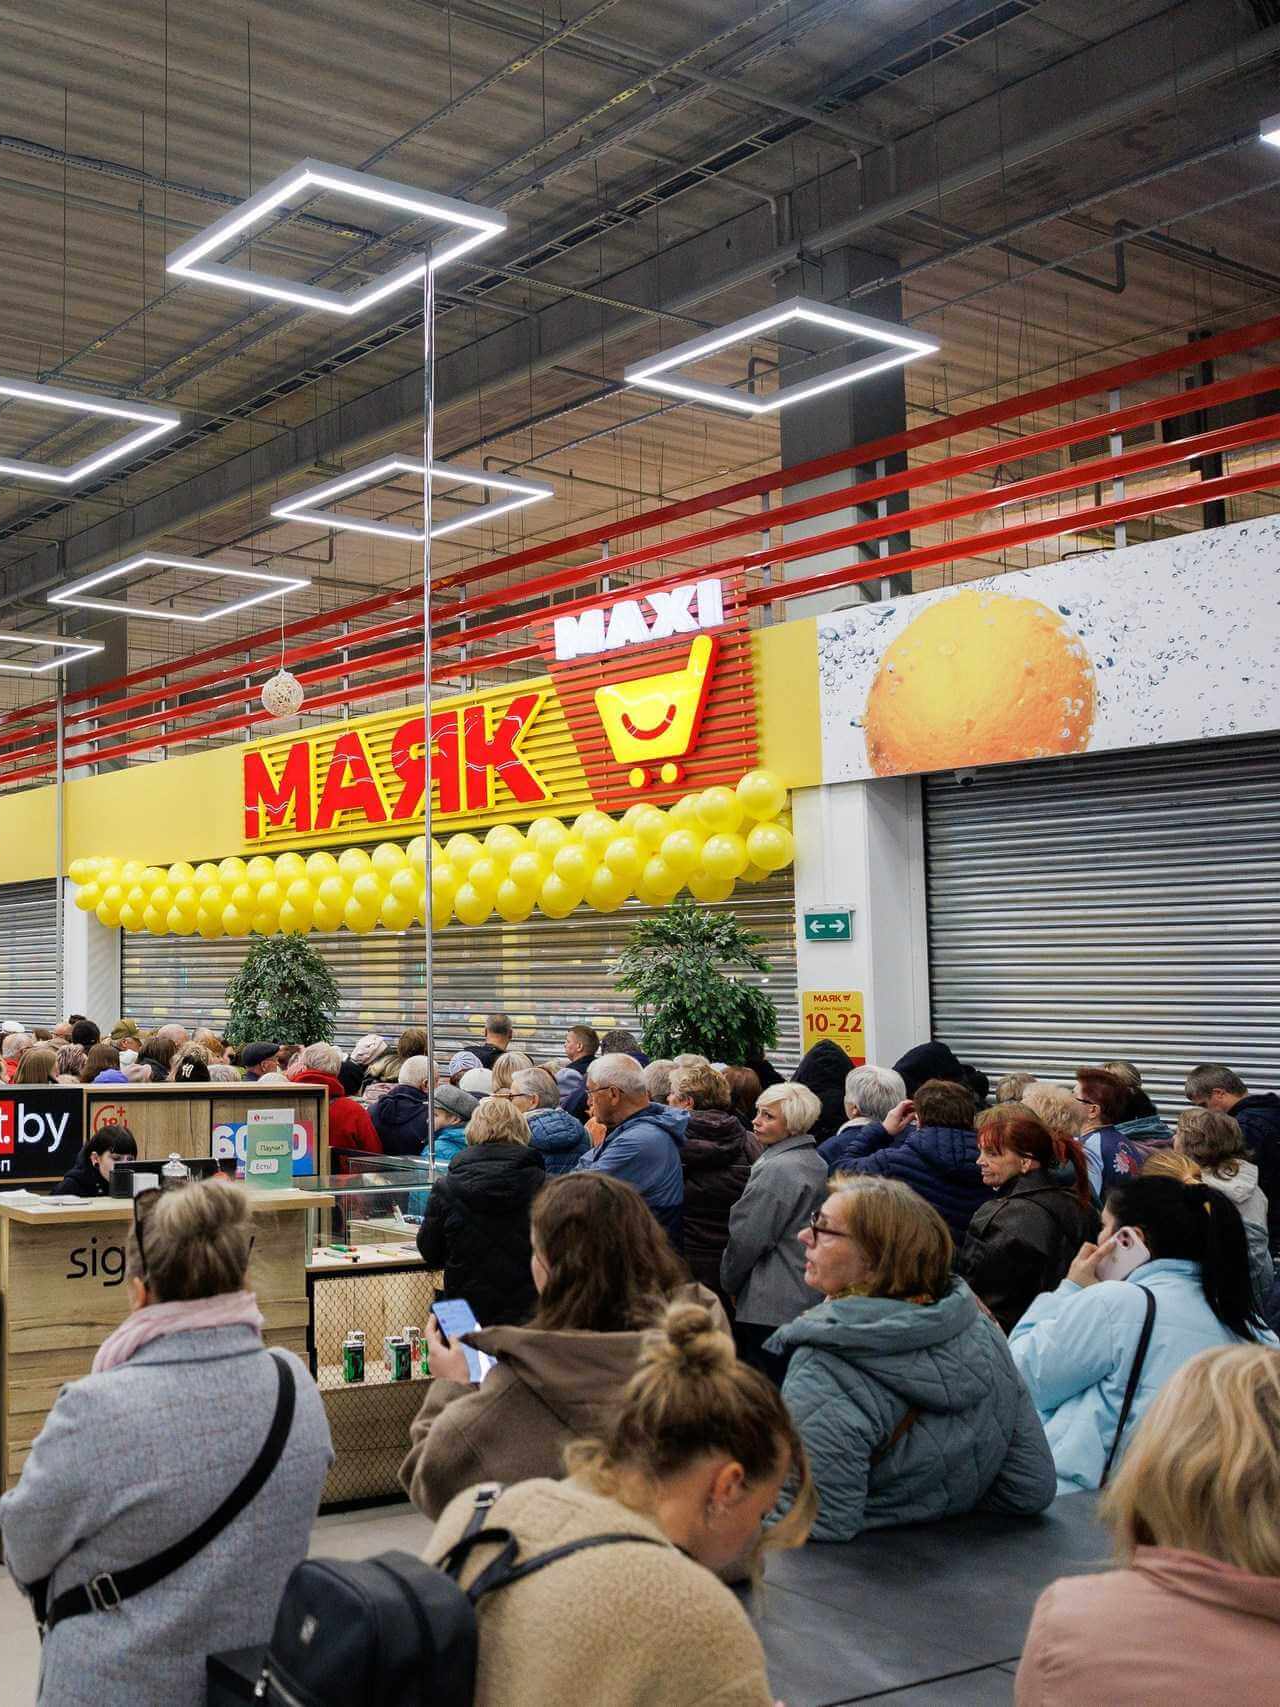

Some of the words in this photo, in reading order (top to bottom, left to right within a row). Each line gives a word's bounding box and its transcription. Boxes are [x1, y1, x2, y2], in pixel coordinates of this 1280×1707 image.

[554, 578, 725, 660] MAXI
[243, 693, 551, 840] МАЯК
[813, 994, 841, 1002] МАЯК
[806, 1013, 862, 1033] 10-22
[255, 1162, 273, 1170] Есть!
